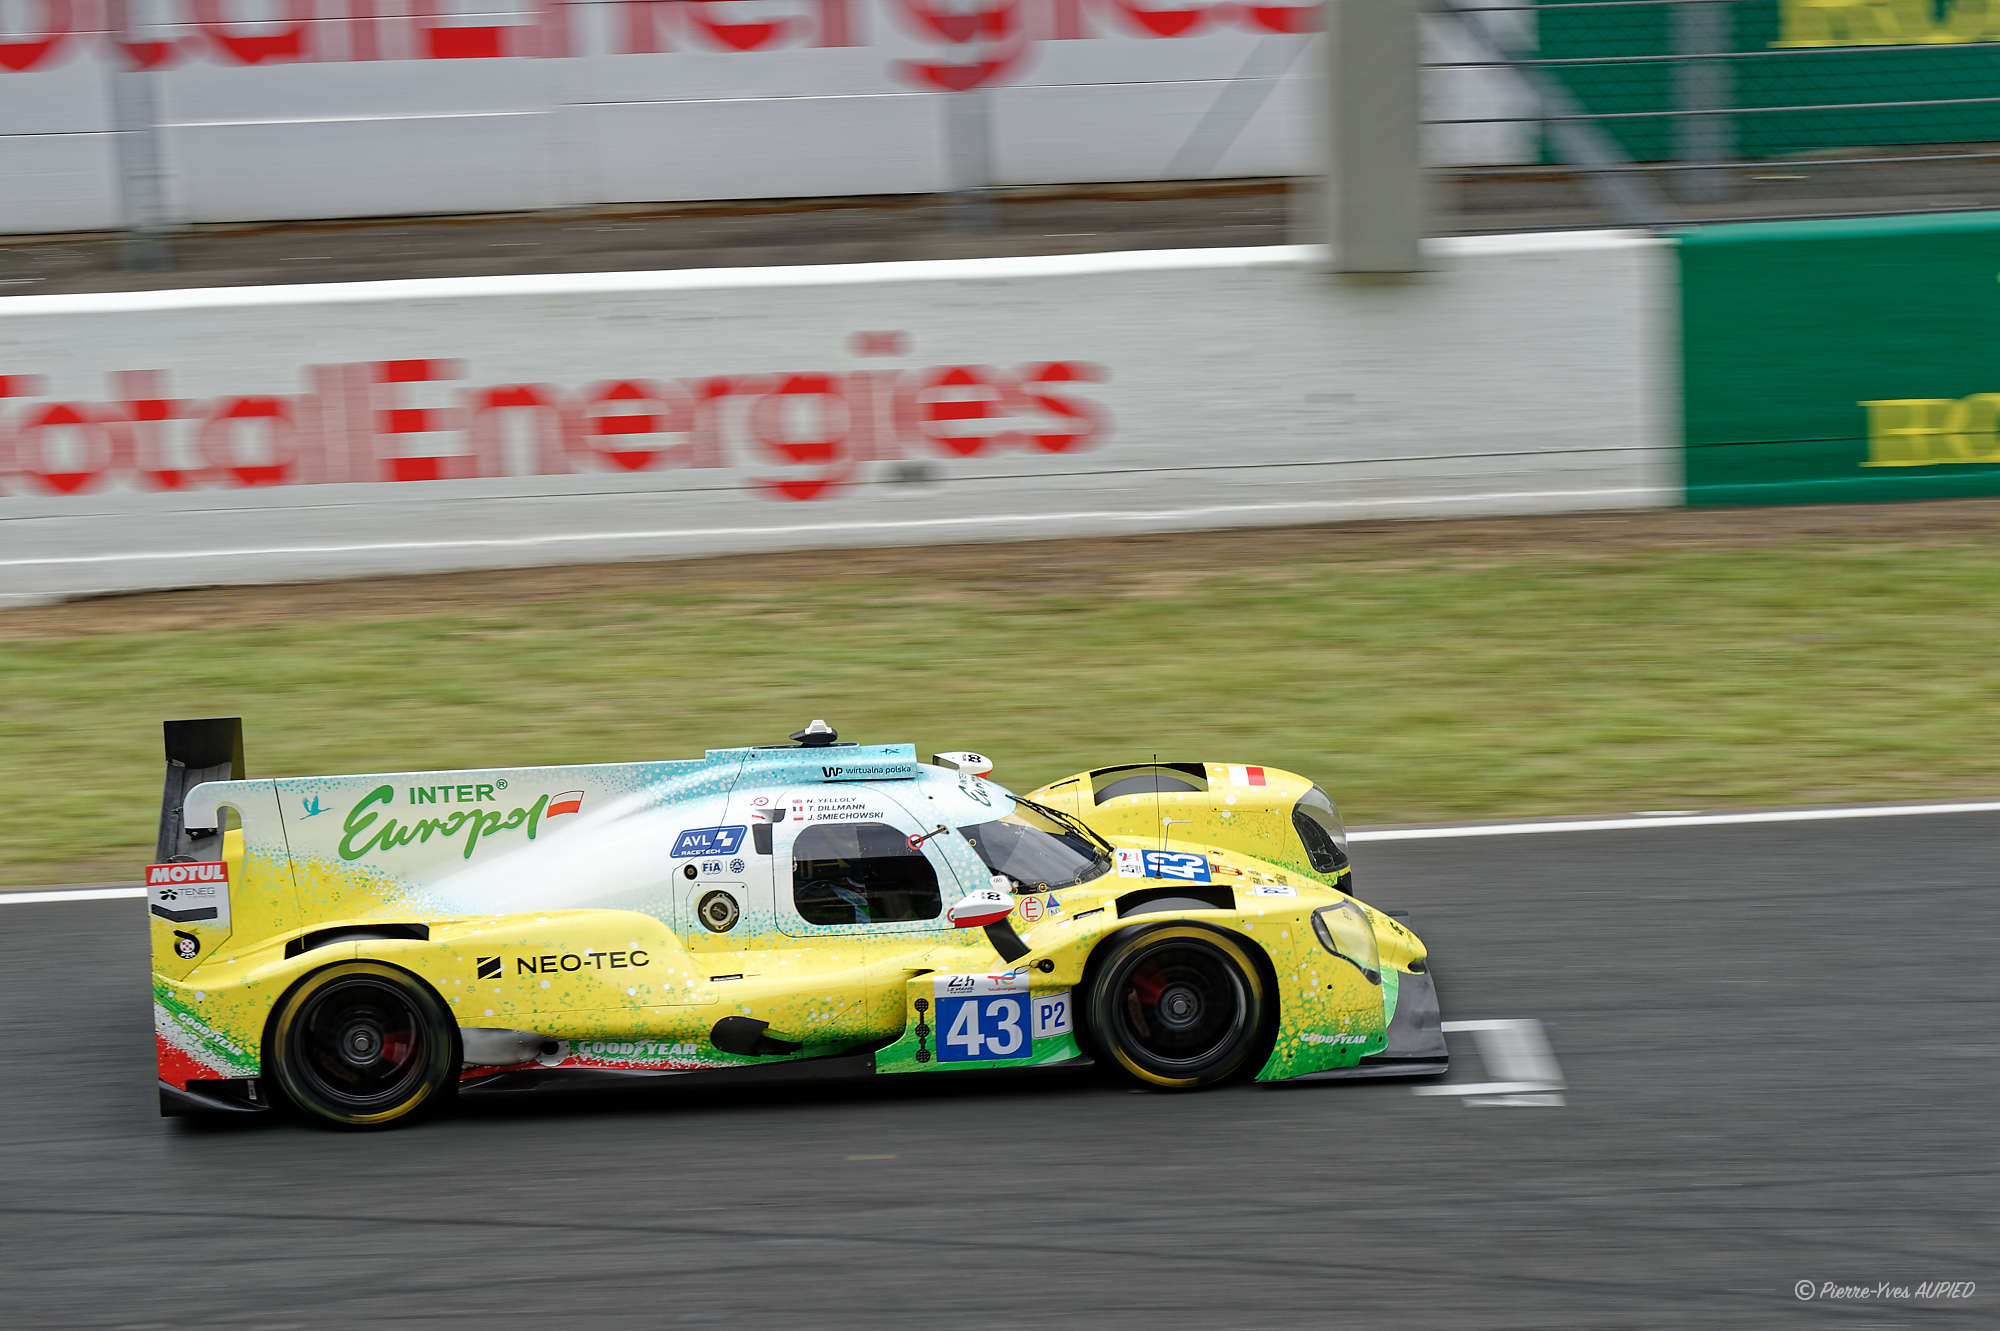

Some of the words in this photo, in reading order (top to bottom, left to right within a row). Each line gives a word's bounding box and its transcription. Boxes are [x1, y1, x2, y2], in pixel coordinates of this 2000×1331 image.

[846, 766, 884, 774] wirtualna
[885, 765, 911, 775] polska
[818, 804, 865, 812] DILLMANN
[338, 784, 549, 861] Europol
[681, 834, 711, 848] AVL
[680, 848, 721, 856] RACETECH
[149, 864, 225, 883] MOTUL
[1145, 852, 1205, 879] 43
[517, 950, 650, 975] NEO-TEC
[1040, 1001, 1066, 1031] P2
[946, 999, 1023, 1056] 43
[578, 1039, 698, 1057] GOODYEAR
[1300, 1033, 1367, 1046] GOODYEAR
